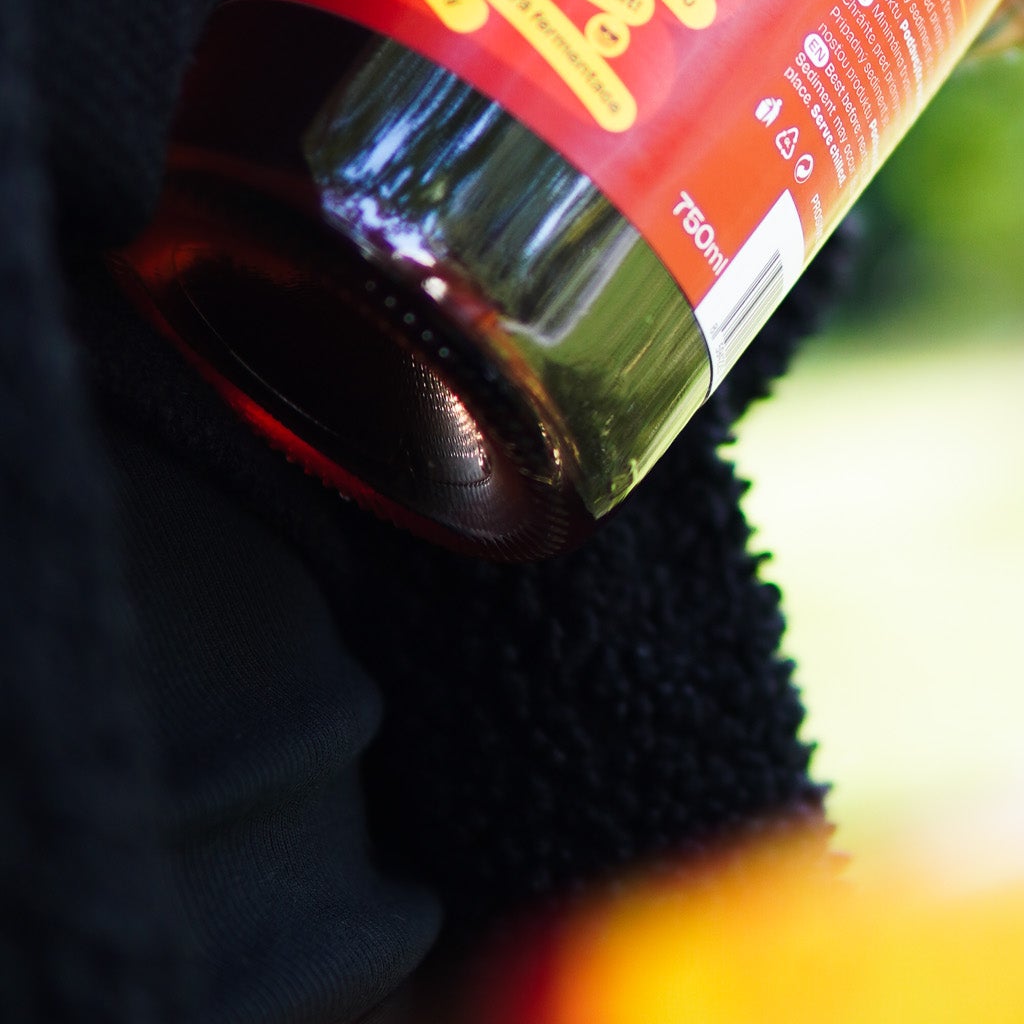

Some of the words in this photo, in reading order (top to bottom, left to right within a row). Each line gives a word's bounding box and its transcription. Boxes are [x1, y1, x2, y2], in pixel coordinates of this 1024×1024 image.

[530, 10, 621, 114] fermentace
[795, 50, 838, 118] Sediment
[832, 114, 849, 144] may
[807, 38, 828, 63] EN
[824, 61, 847, 98] Best
[871, 42, 892, 73] pred
[783, 66, 813, 109] place.
[810, 103, 835, 146] Serve
[672, 190, 729, 276] 750ml
